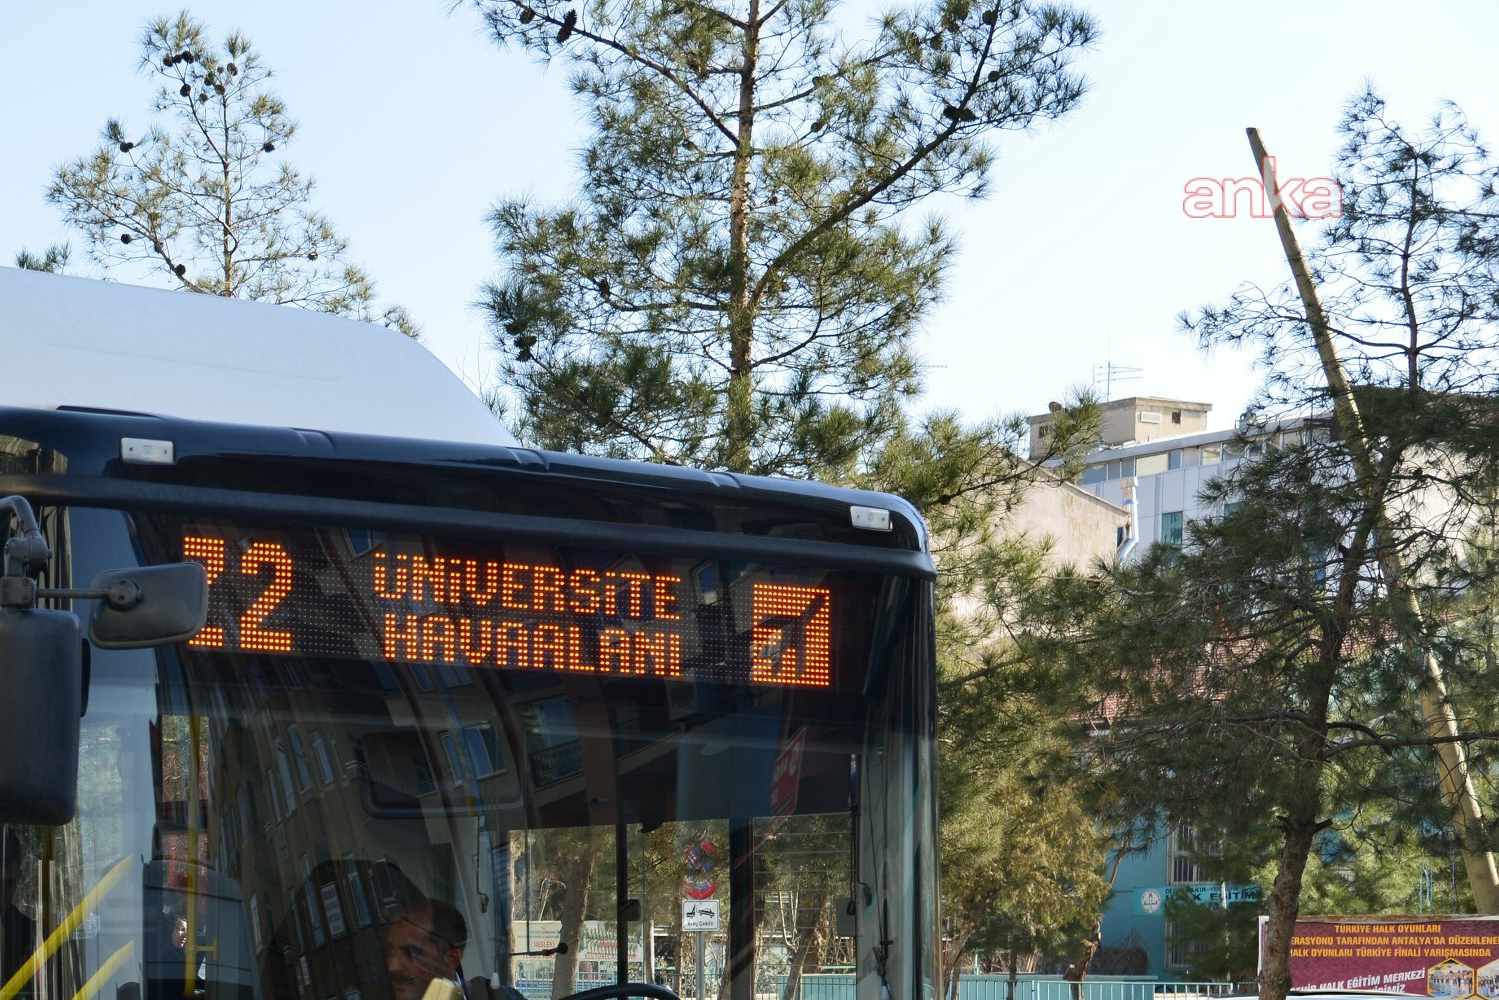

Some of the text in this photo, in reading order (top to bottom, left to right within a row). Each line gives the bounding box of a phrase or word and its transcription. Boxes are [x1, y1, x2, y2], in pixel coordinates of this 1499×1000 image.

[374, 552, 682, 620] ÜNİVERSİTE
[384, 612, 682, 678] HAVAALANI
[1335, 924, 1441, 933] TÜRKİYE HALK OYUNLARI
[1336, 936, 1389, 945] TARAFINDAN
[1392, 936, 1445, 945] ANTALYA'DA
[1311, 948, 1353, 957] OYUNLARI
[1355, 948, 1392, 957] TÜRKİYE
[1394, 947, 1420, 957] FİNALİ
[1423, 948, 1491, 959] YARIŞMASINDA
[1347, 975, 1380, 989] EĞİTİM
[1383, 967, 1426, 983] MERKEZİ
